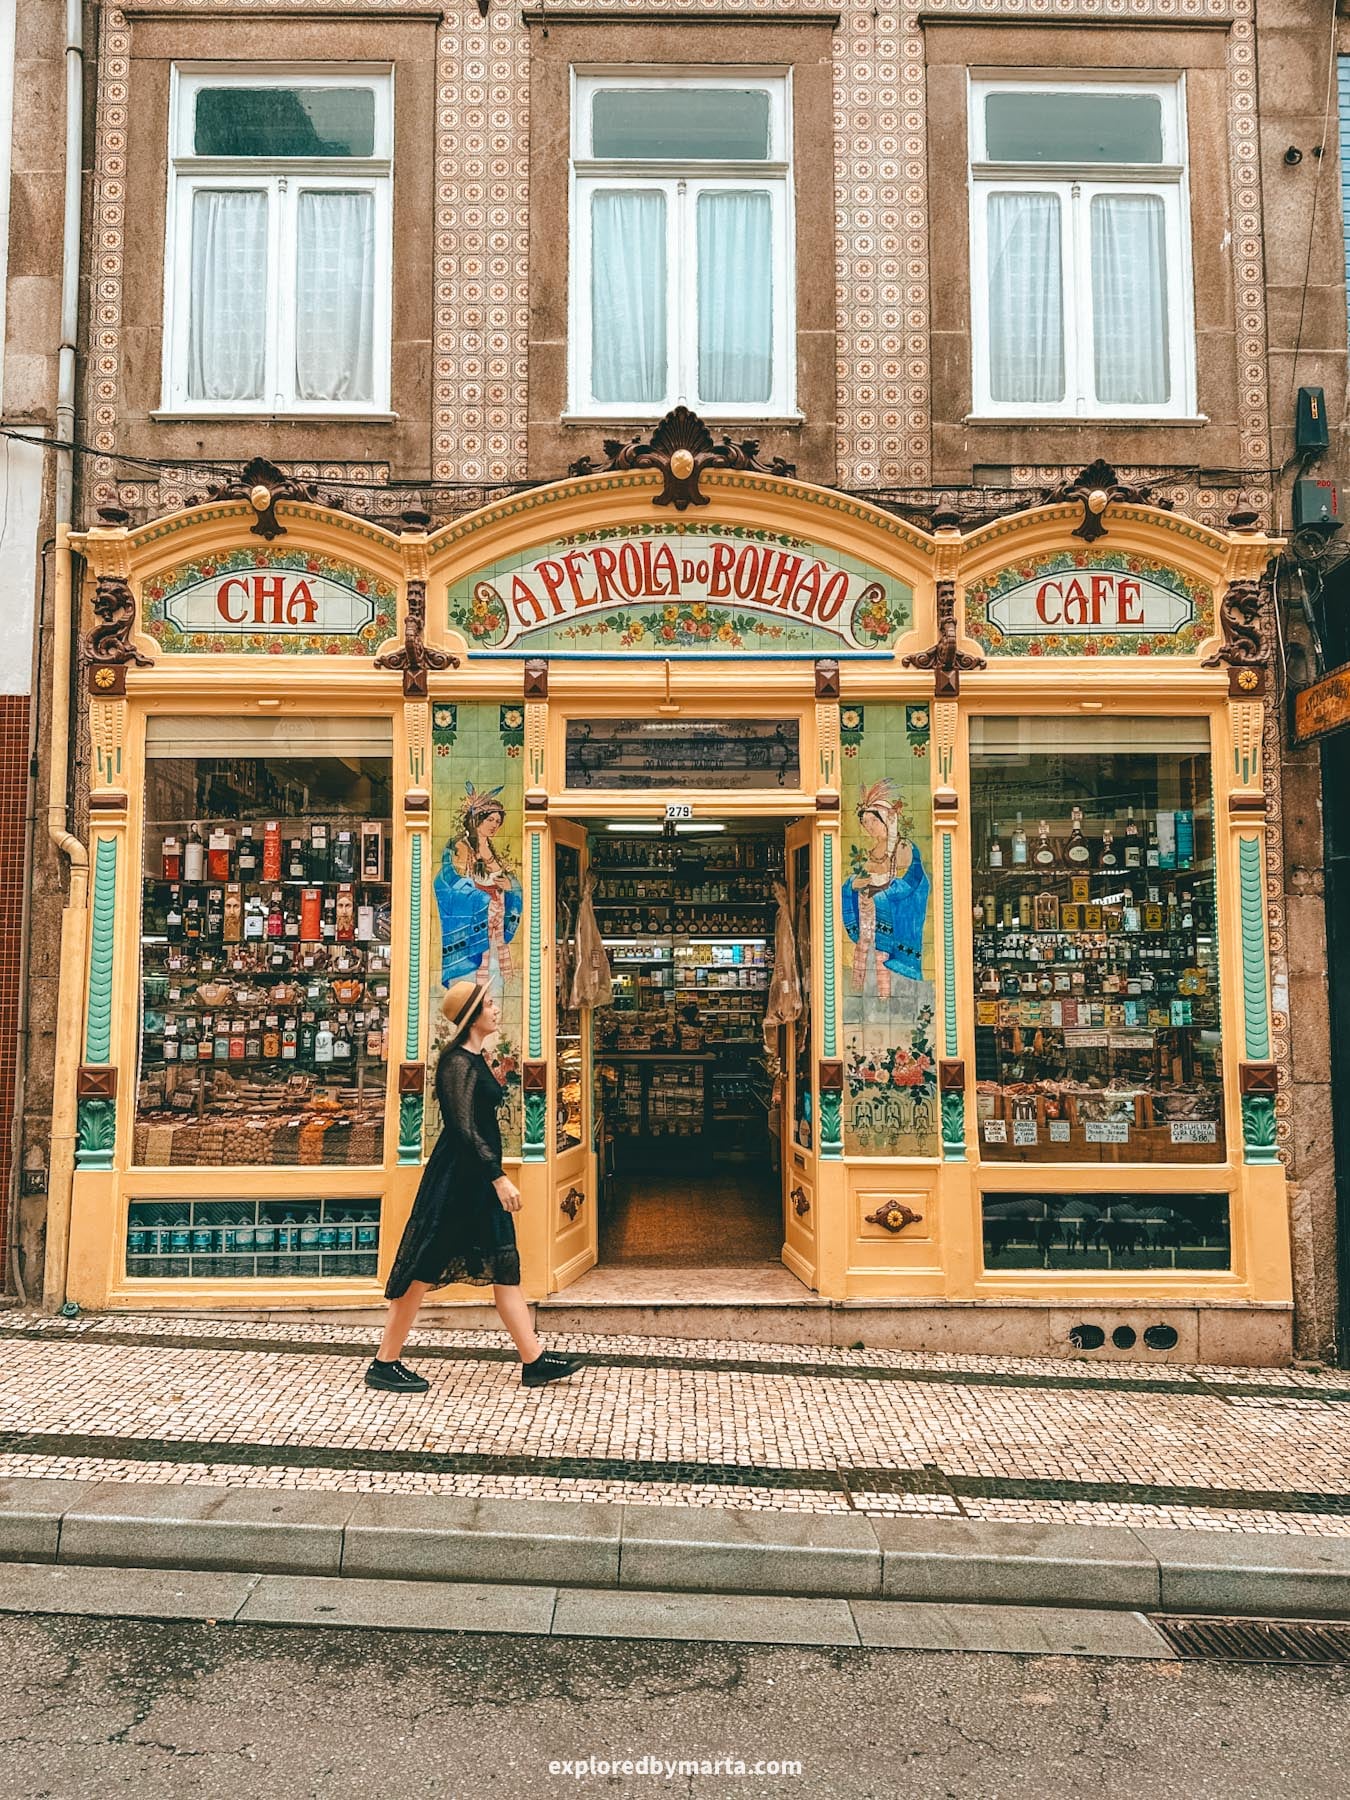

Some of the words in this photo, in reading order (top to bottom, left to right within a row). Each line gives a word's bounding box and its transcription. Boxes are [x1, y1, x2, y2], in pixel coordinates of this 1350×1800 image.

[216, 576, 318, 625] CHÁ
[510, 573, 547, 626] A
[534, 540, 680, 622] PÉROLA
[707, 542, 850, 622] BOLHÃO
[1035, 575, 1145, 625] CAFÉ
[669, 806, 689, 817] 279
